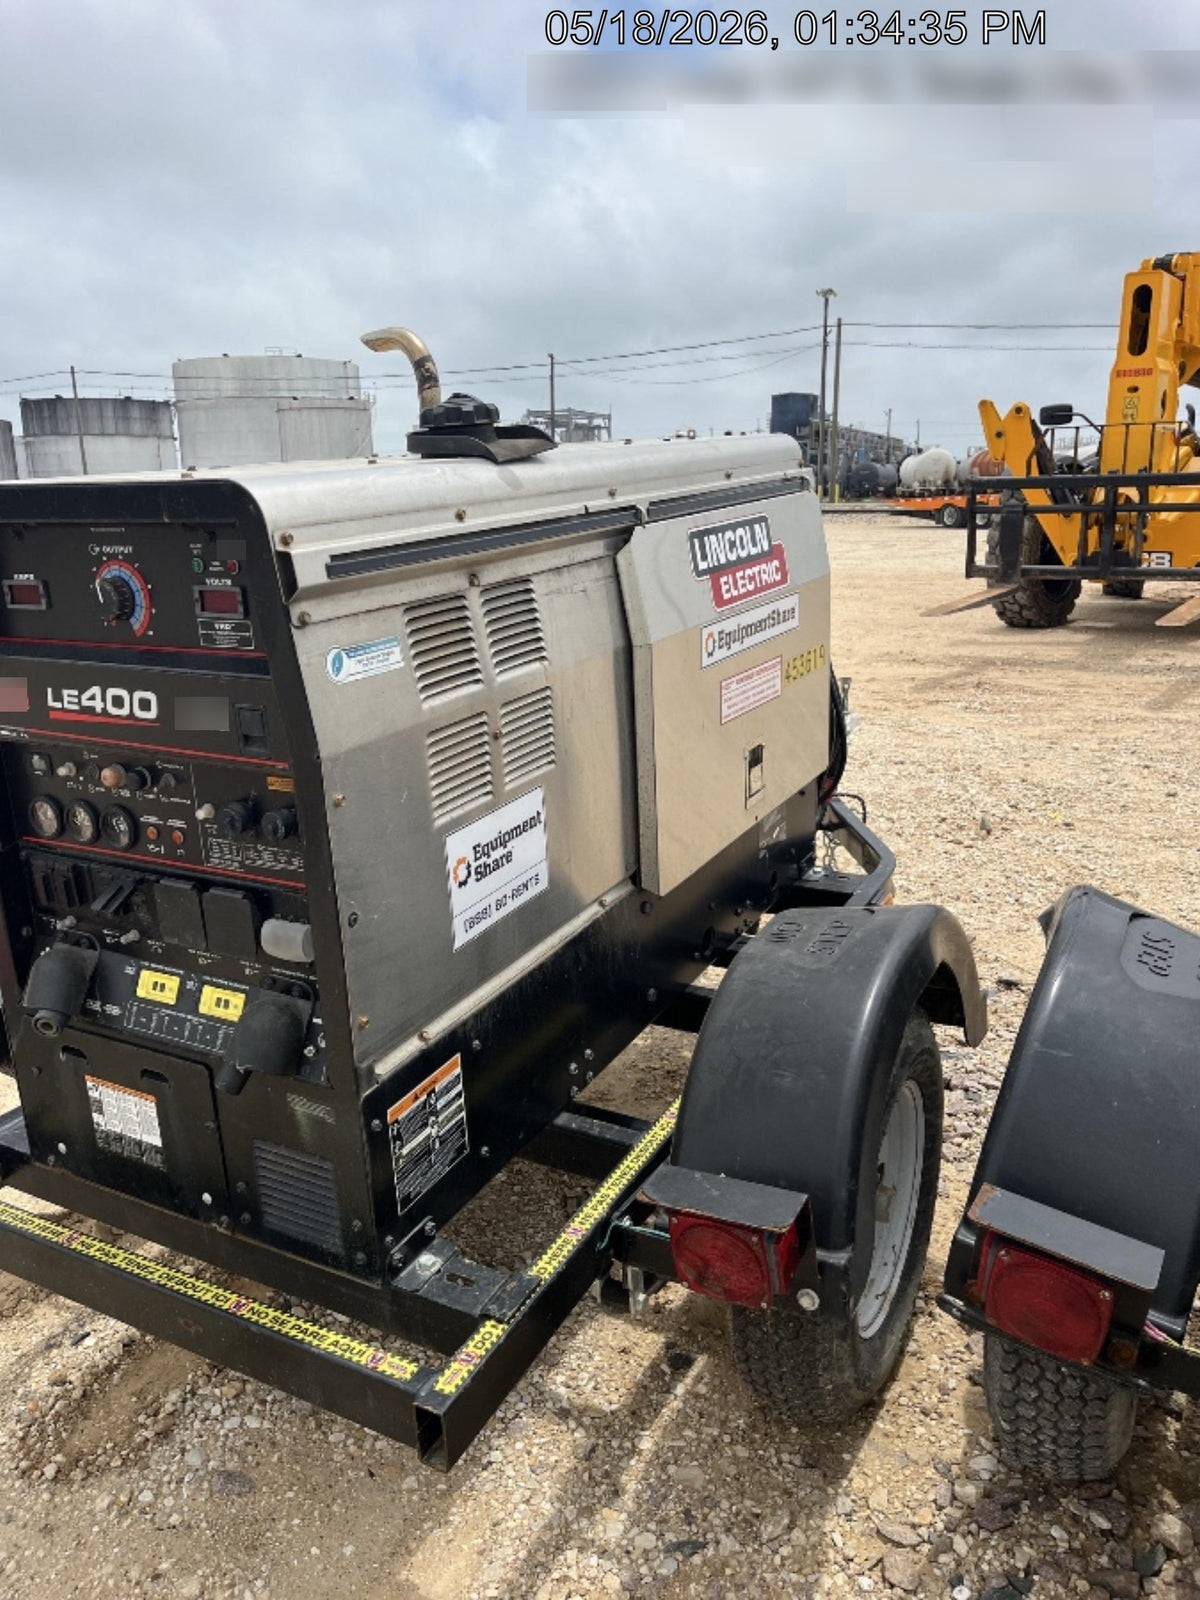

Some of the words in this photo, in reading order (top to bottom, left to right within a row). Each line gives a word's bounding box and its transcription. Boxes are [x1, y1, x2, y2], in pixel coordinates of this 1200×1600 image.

[693, 522, 770, 571] LINCOLN
[719, 560, 782, 600] ELECTRIC
[717, 605, 796, 651] EquipmentShare
[47, 686, 158, 720] LE400
[472, 811, 542, 862] Equipment
[474, 850, 513, 883] Share
[247, 1307, 270, 1321] NO
[270, 1315, 291, 1328] SE
[290, 1322, 330, 1343] PARE
[329, 1337, 368, 1359] AQUI
[472, 1330, 494, 1352] DO
